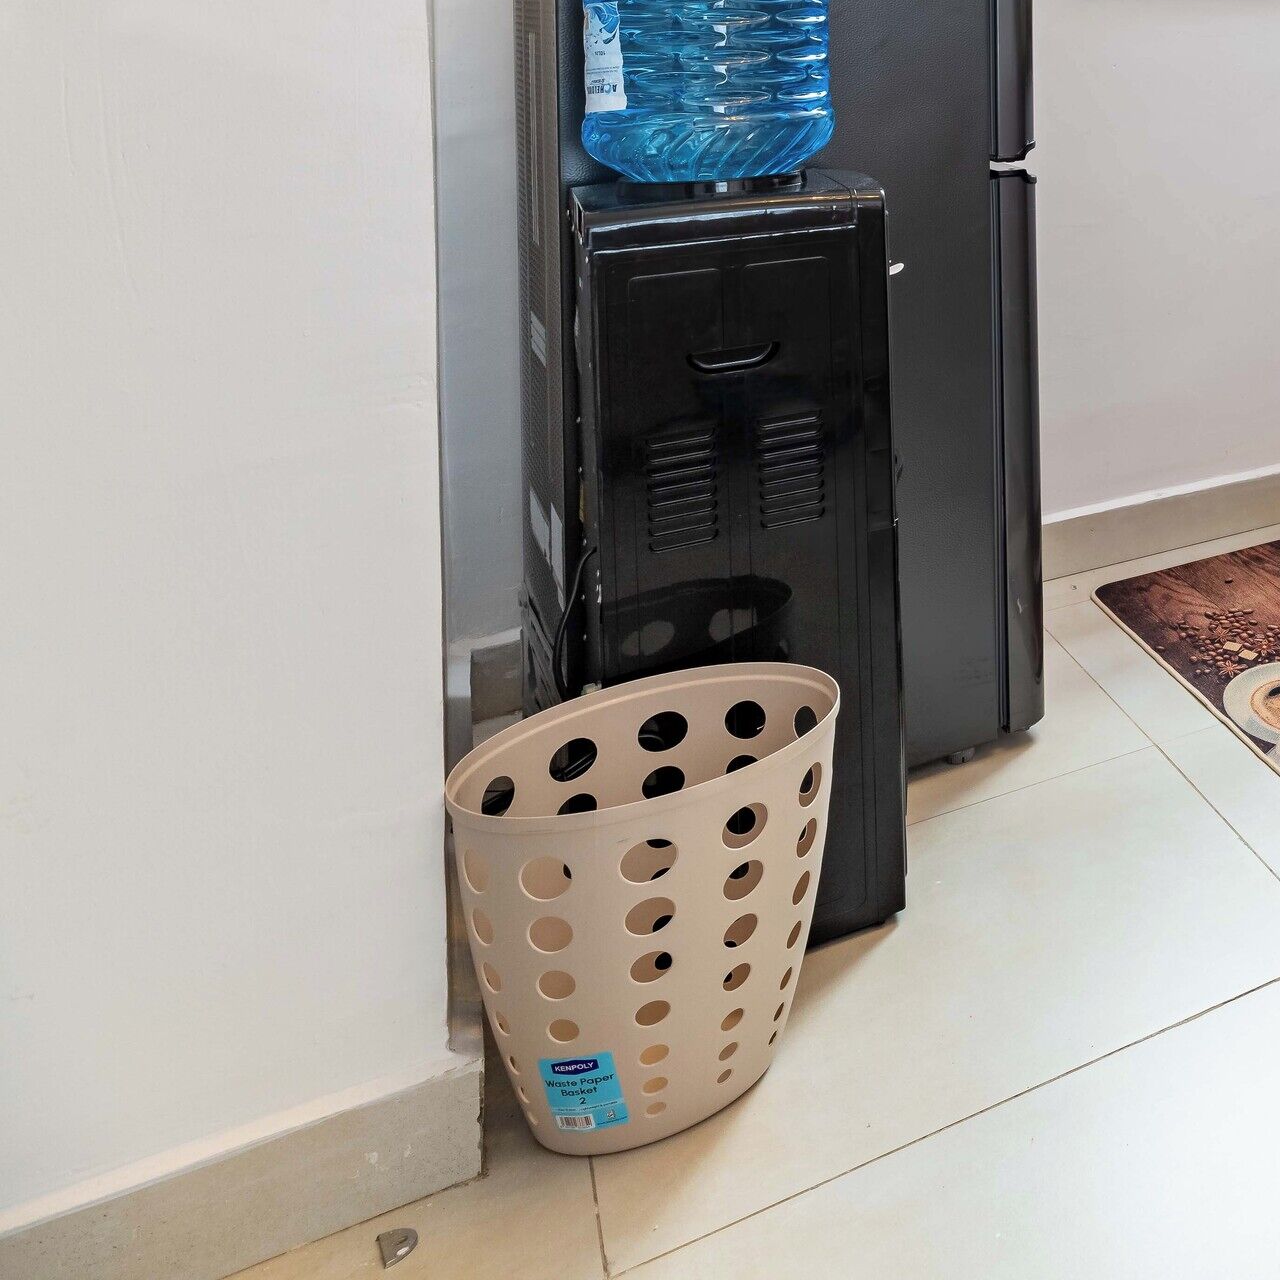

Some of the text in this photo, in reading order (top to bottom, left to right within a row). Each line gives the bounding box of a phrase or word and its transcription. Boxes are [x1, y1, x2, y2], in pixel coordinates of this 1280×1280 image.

[554, 1062, 594, 1072] KENPOLY
[580, 1073, 614, 1085] Paper
[561, 1086, 597, 1097] Basket
[579, 1097, 587, 1105] 2
